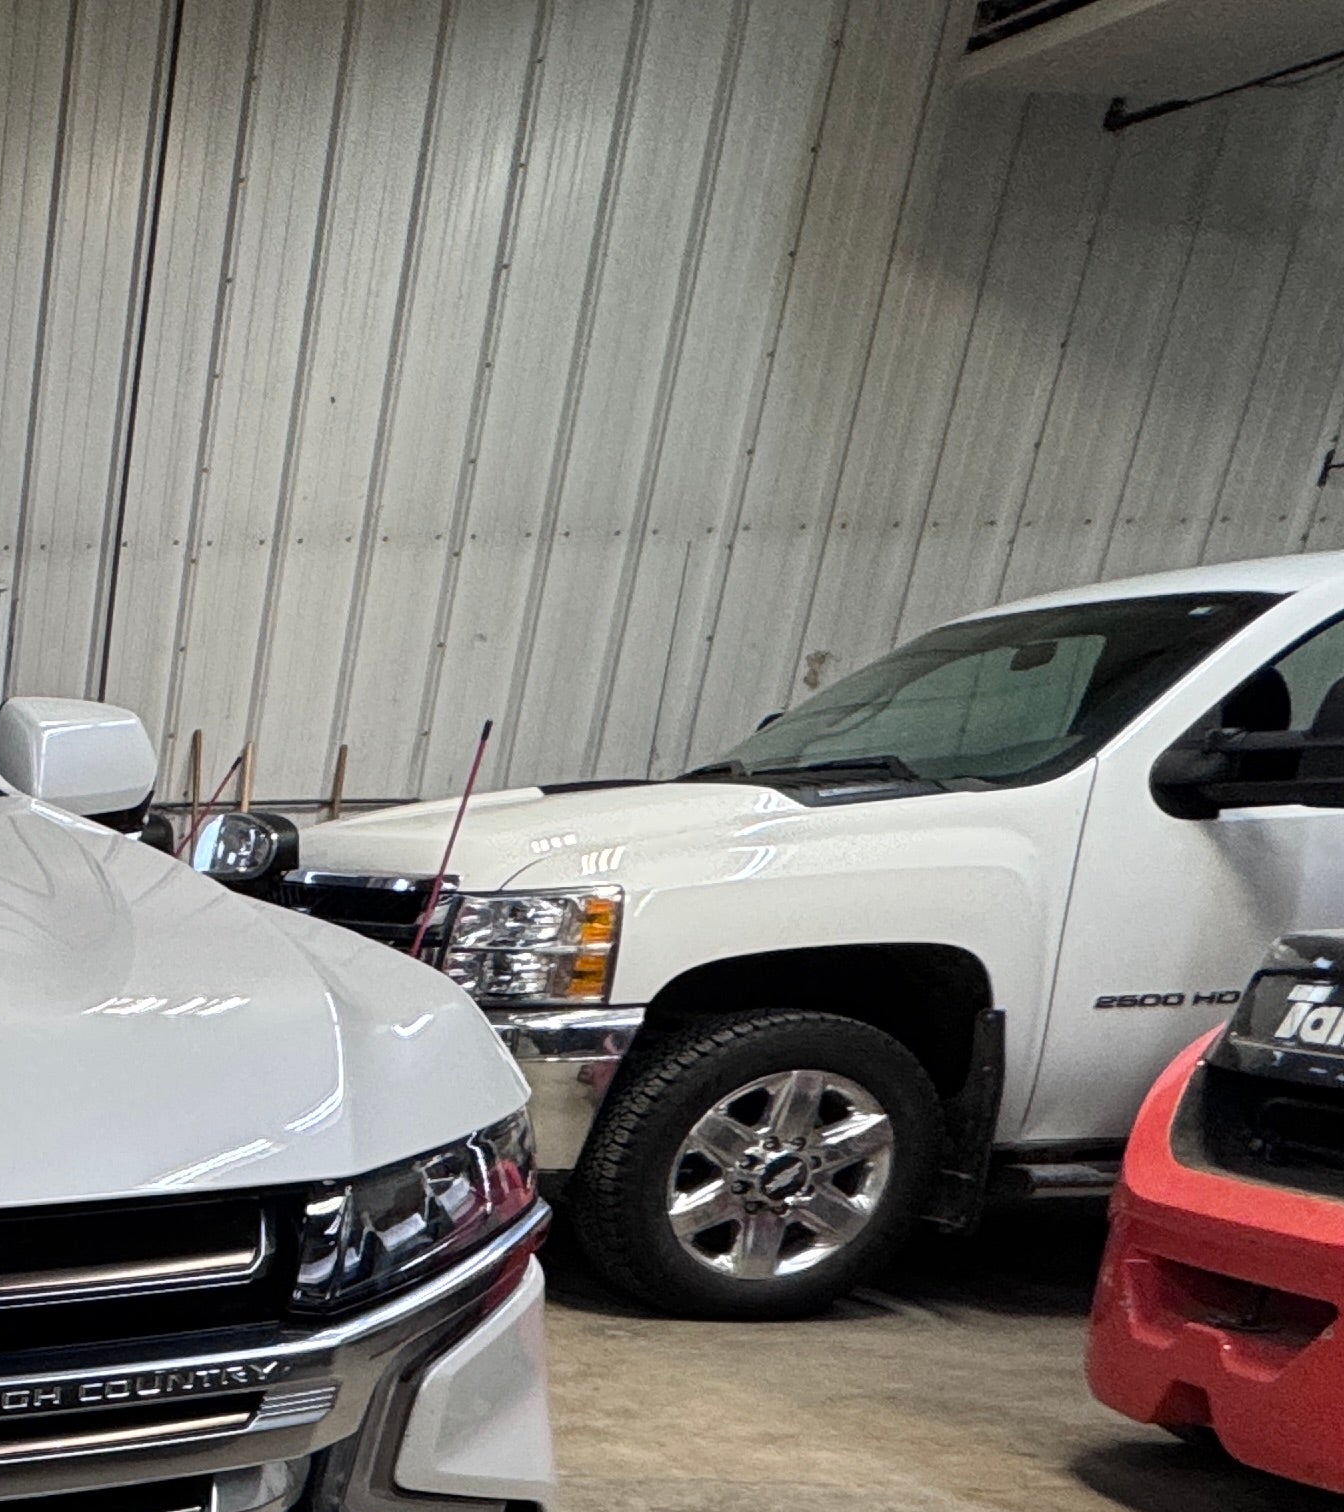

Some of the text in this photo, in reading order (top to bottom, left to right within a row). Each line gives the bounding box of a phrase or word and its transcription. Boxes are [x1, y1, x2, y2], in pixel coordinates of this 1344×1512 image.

[1093, 990, 1241, 1009] 2500 HD
[78, 1361, 278, 1402] COUNTRY
